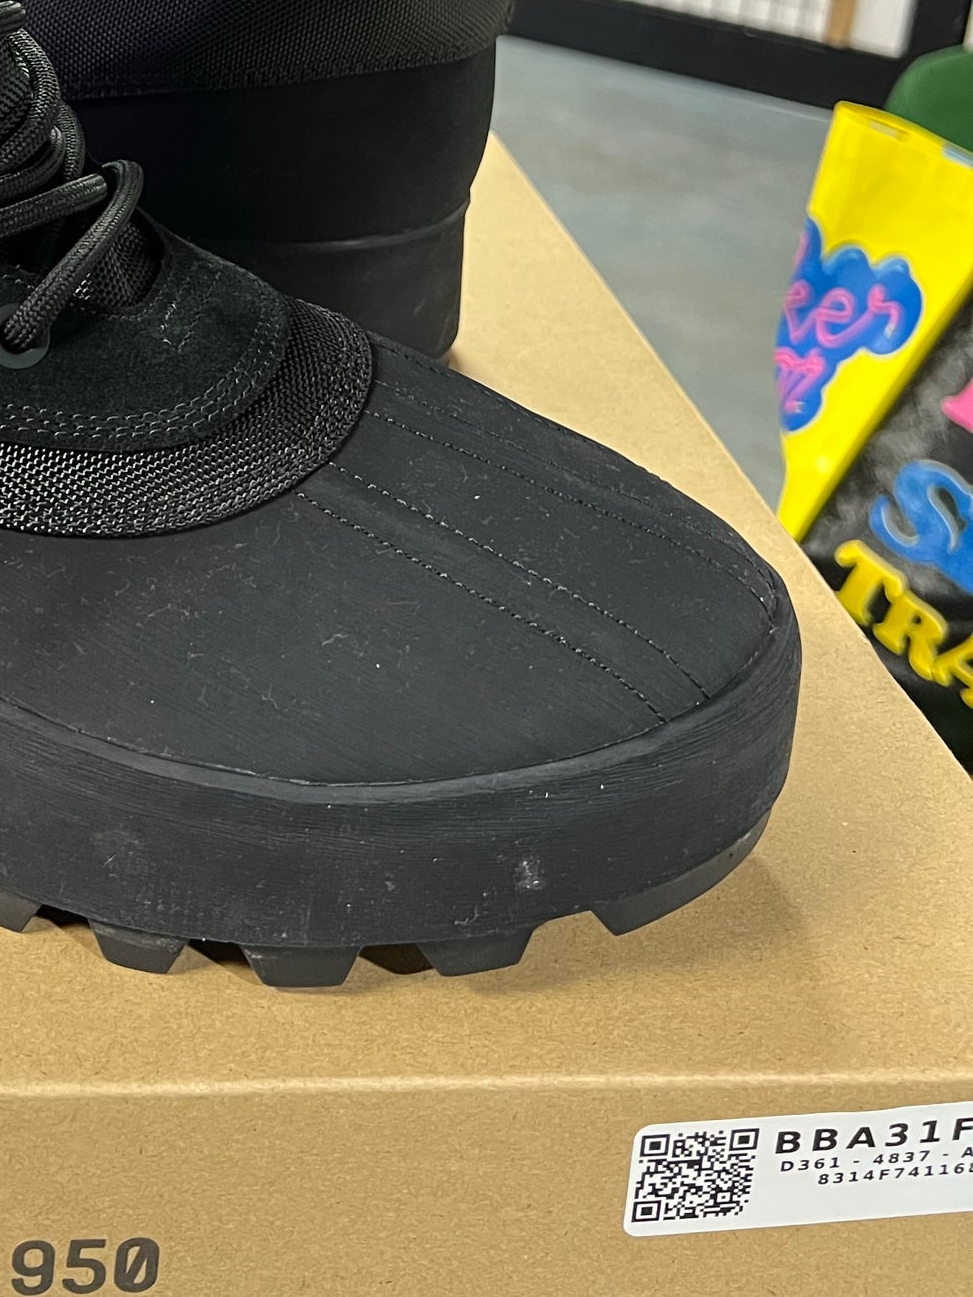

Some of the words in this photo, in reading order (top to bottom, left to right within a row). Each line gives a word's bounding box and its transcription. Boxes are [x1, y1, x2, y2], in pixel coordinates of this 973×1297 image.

[775, 1117, 973, 1154] BBA31F
[780, 1157, 840, 1172] D361
[873, 1150, 930, 1165] 4837
[11, 1237, 160, 1296] 950
